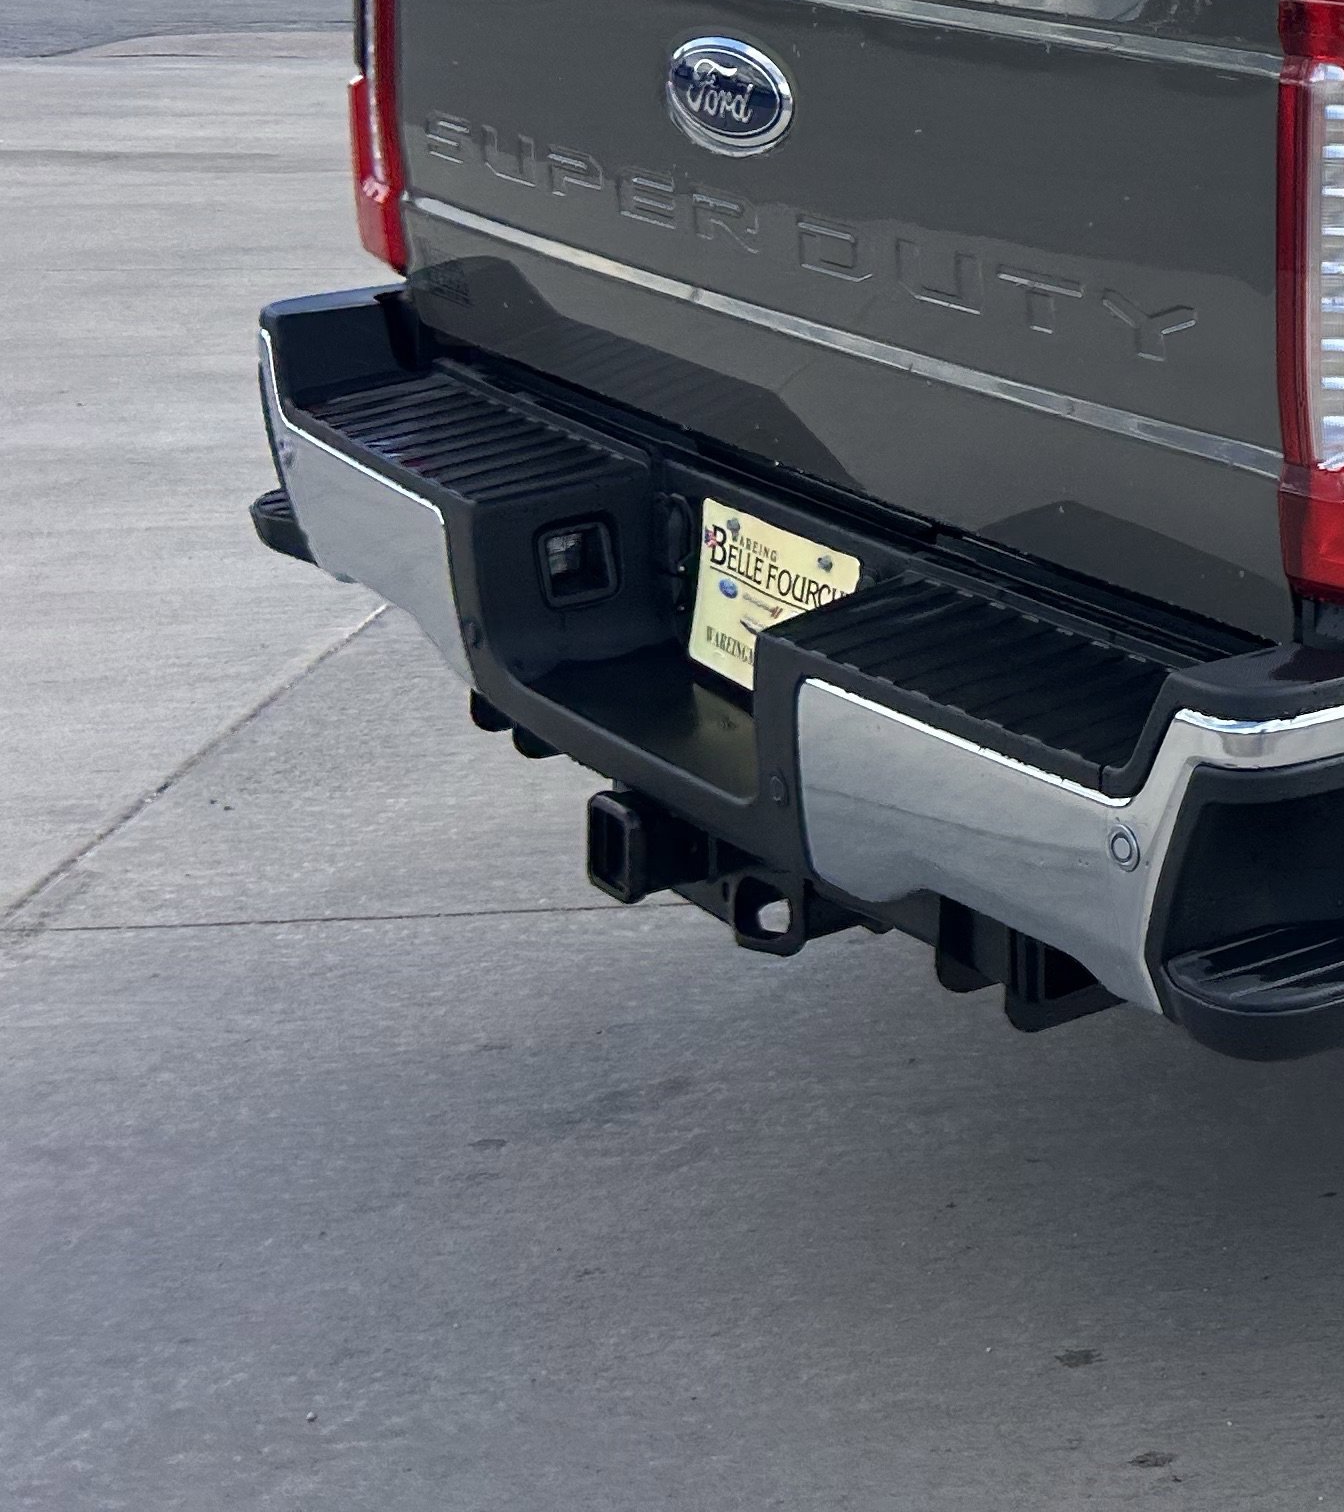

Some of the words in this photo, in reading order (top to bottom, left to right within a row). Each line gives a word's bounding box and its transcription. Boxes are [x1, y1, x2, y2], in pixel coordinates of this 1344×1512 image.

[687, 58, 754, 124] Ford
[424, 110, 761, 254] SUPER
[795, 214, 1198, 362] DUTY
[710, 524, 762, 585] BELLE
[765, 563, 849, 608] FOURC
